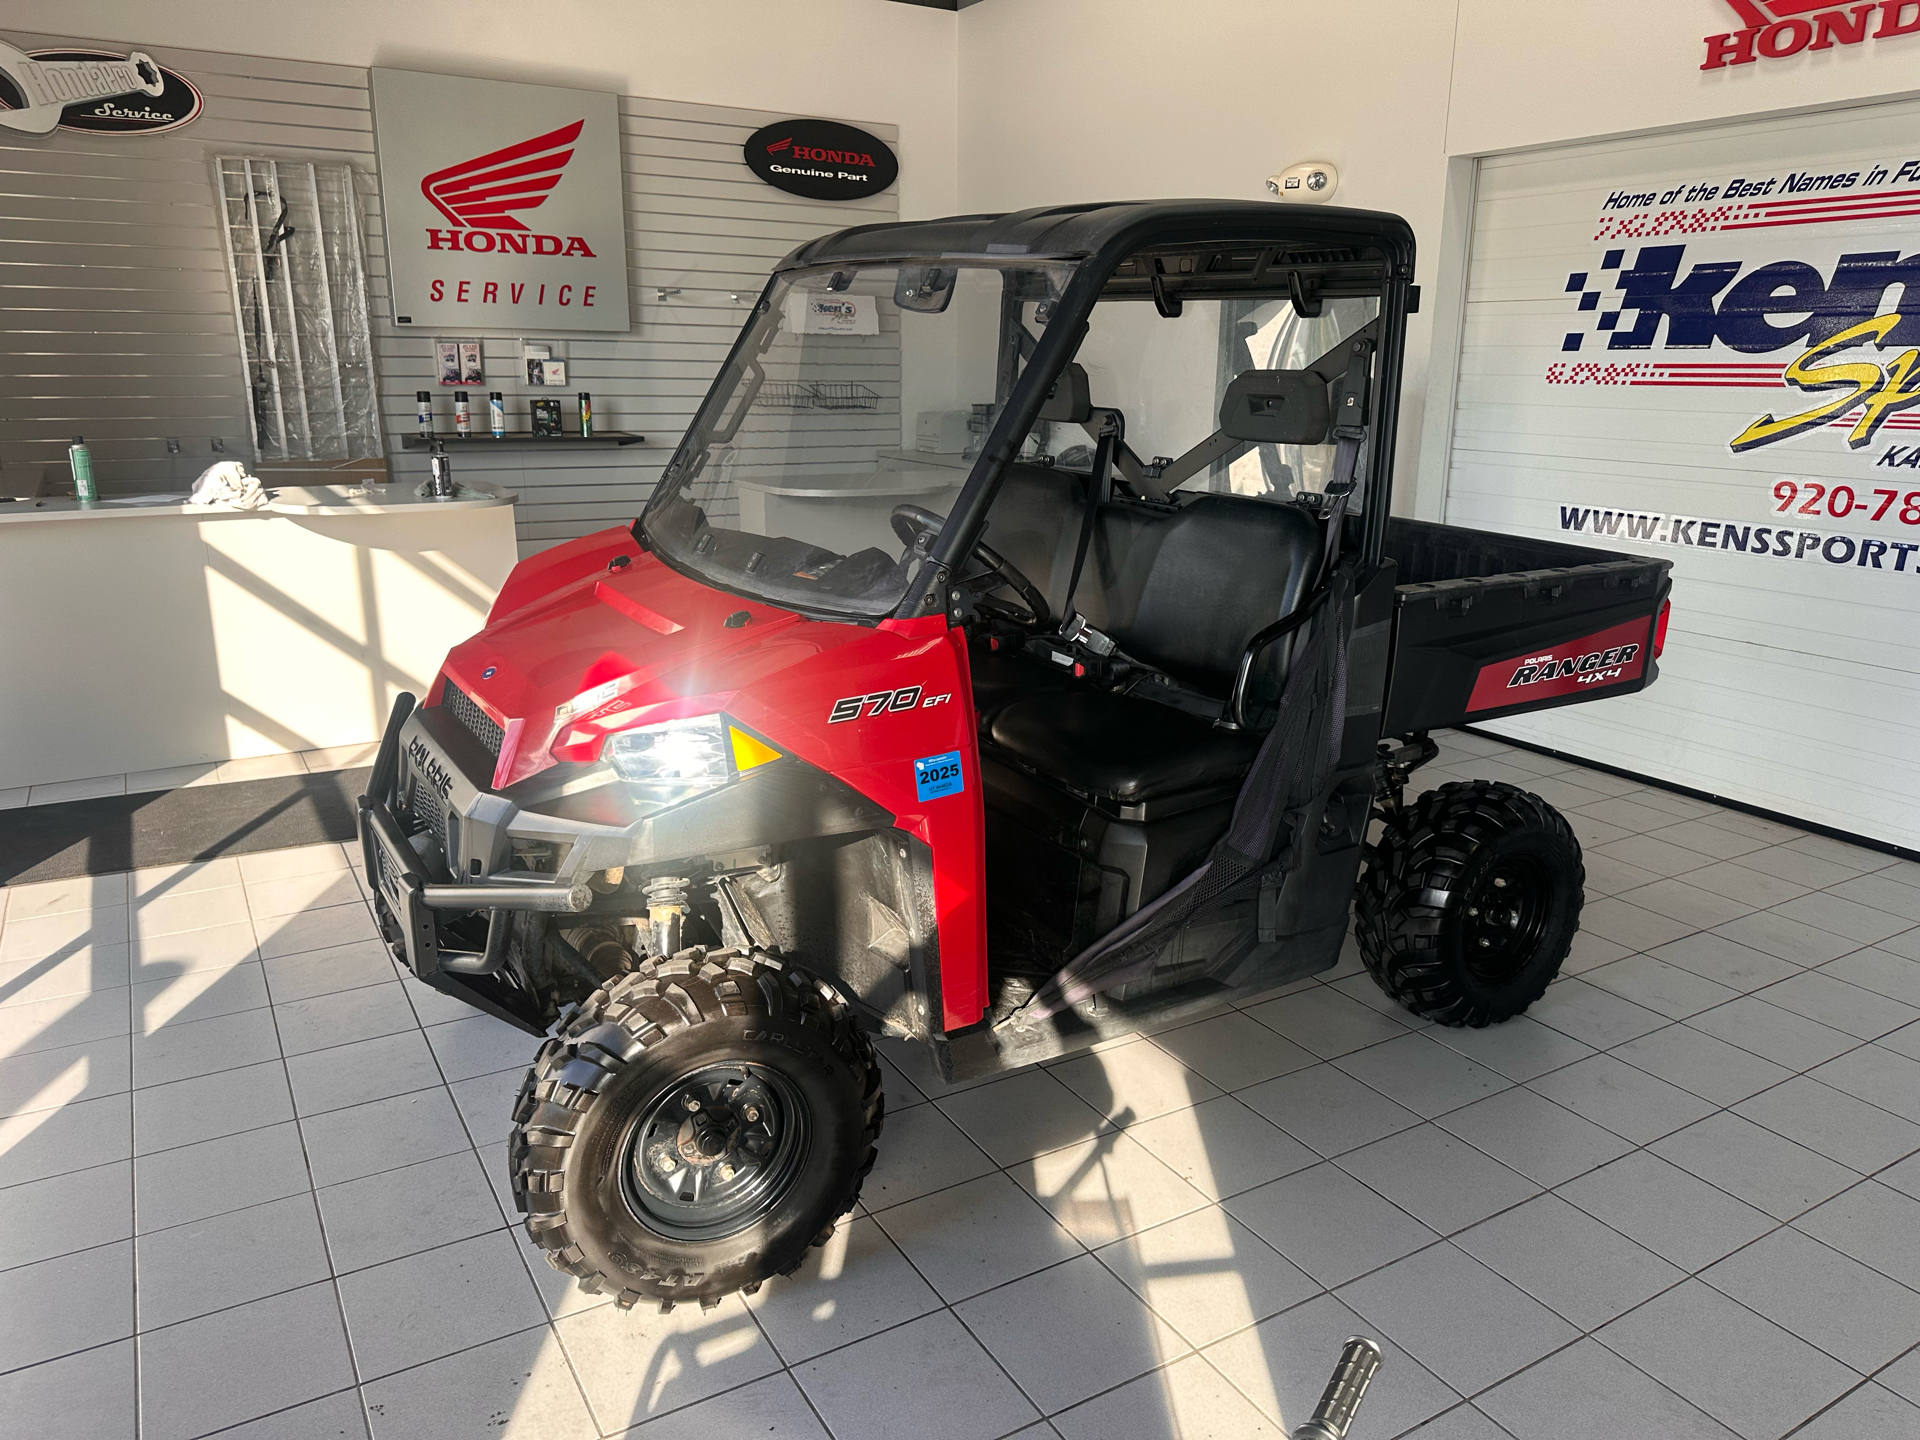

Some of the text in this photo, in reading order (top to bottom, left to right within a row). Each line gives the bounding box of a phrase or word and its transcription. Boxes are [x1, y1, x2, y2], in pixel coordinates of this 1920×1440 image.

[17, 61, 137, 106] HondaPro
[95, 102, 175, 121] Service
[792, 146, 876, 167] HONDA
[769, 164, 868, 182] Genuine Part
[1602, 191, 1657, 211] Home
[1659, 185, 1686, 205] of
[1684, 182, 1719, 203] the
[1721, 178, 1778, 199] Best
[1777, 172, 1860, 194] Names
[1862, 164, 1889, 187] in
[426, 228, 597, 258] HONDA
[430, 279, 597, 307] SERVICE
[1877, 445, 1920, 469] KA
[1773, 481, 1920, 525] 920-78
[1560, 505, 1920, 573] WWW.KENSSPORT
[1506, 643, 1640, 688] RANGER
[1524, 655, 1553, 665] POLARIS
[827, 685, 952, 724] 570 EFI
[919, 763, 960, 785] 2025
[607, 1251, 705, 1287] AT489
